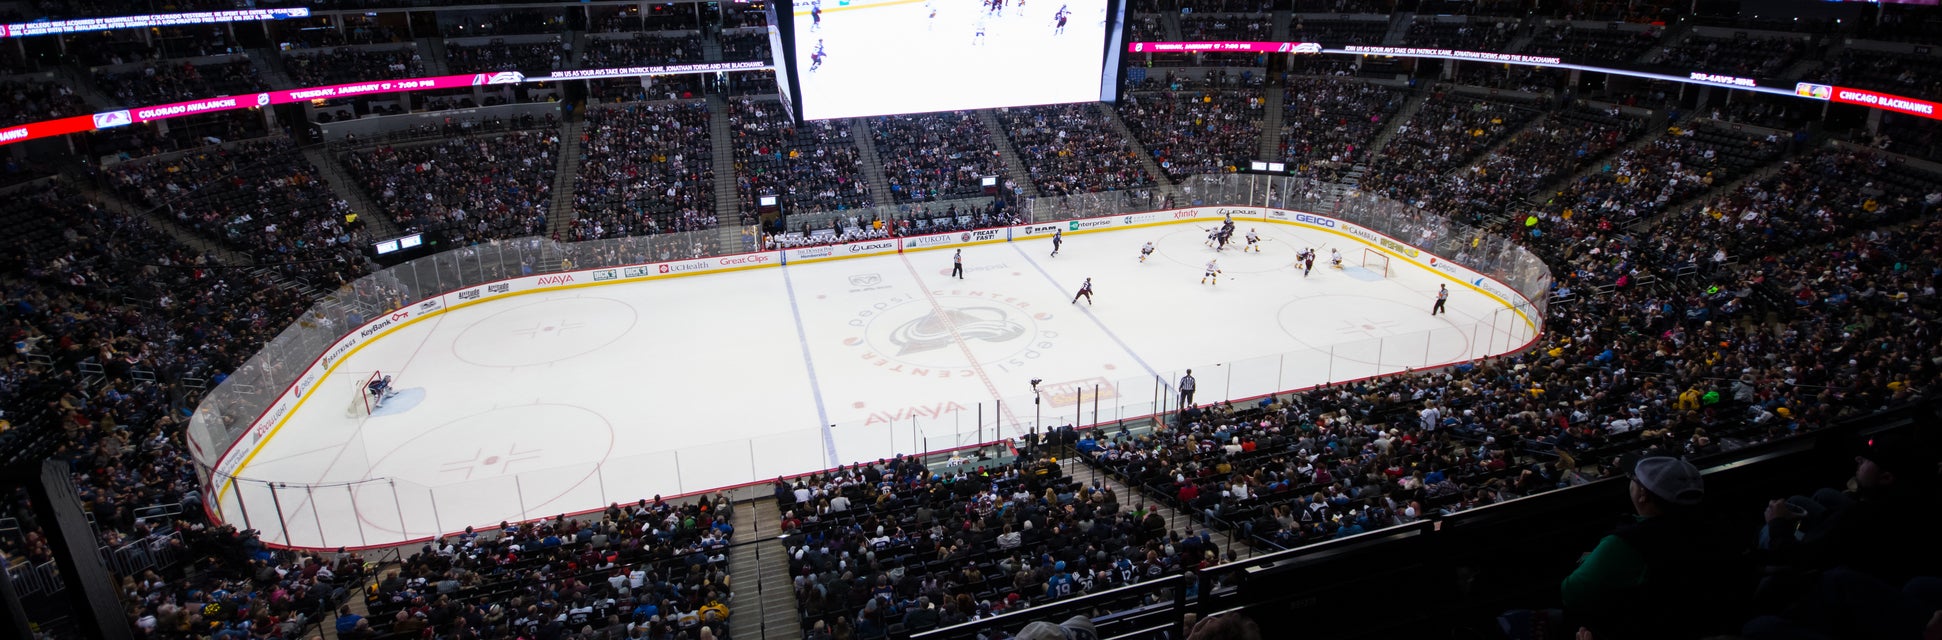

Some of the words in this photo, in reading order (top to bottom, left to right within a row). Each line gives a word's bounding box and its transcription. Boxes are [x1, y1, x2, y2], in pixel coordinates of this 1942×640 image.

[1522, 56, 1559, 64] BLACKHAWKS
[290, 88, 336, 99] TUESDAY,
[338, 84, 379, 94] JANUARY
[139, 106, 186, 118] COLORADO
[187, 99, 236, 112] AVALANCHE
[1839, 91, 1878, 104] CHICAGO
[1878, 96, 1933, 114] BLACKHAWKS
[1174, 210, 1198, 219] xfinity
[1296, 214, 1335, 228] GEICO
[1072, 220, 1110, 229] enterprise
[918, 235, 951, 243] VUKOTA
[1349, 226, 1377, 242] CAMBRIA
[720, 257, 746, 265] Great
[747, 255, 769, 263] Clips
[1438, 263, 1456, 273] pepsi
[537, 275, 574, 285] AVAYA
[932, 290, 1031, 309] CENTER
[848, 293, 912, 327] pepsi
[360, 320, 391, 338] KeyBank
[328, 339, 356, 363] DRAFTKINGS
[273, 403, 287, 420] LIGHT
[864, 401, 968, 426] AVAYA
[1056, 584, 1071, 596] 19
